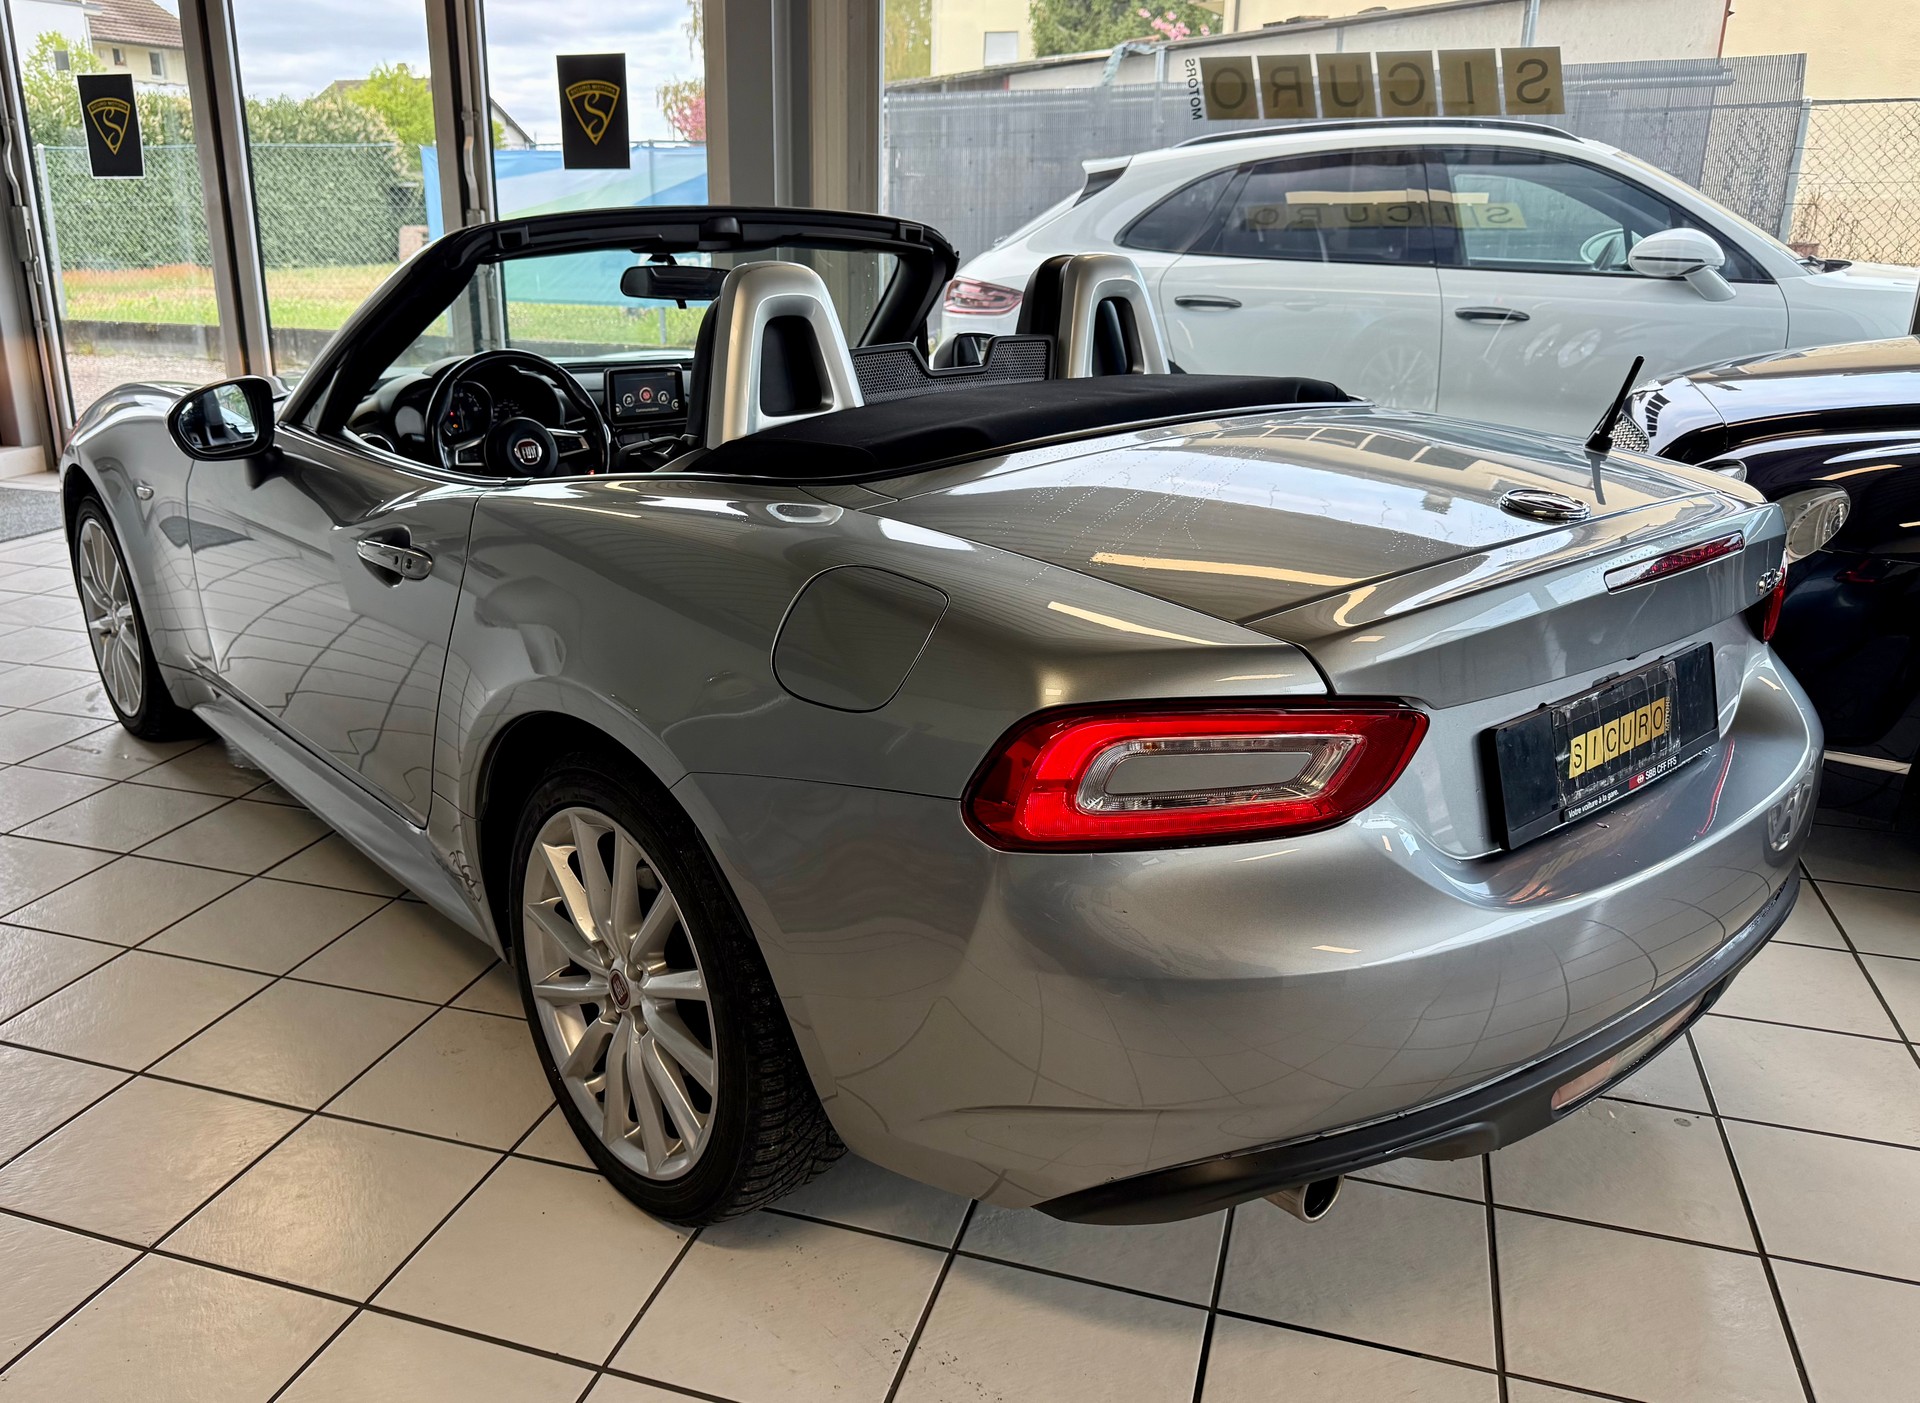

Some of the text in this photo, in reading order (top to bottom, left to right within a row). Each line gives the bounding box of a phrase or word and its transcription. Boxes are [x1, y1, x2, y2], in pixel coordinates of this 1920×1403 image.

[1573, 705, 1664, 769] SICURO
[1645, 755, 1677, 780] SBB CFF FFS
[1568, 807, 1582, 818] Votre
[1582, 799, 1599, 812] voiture
